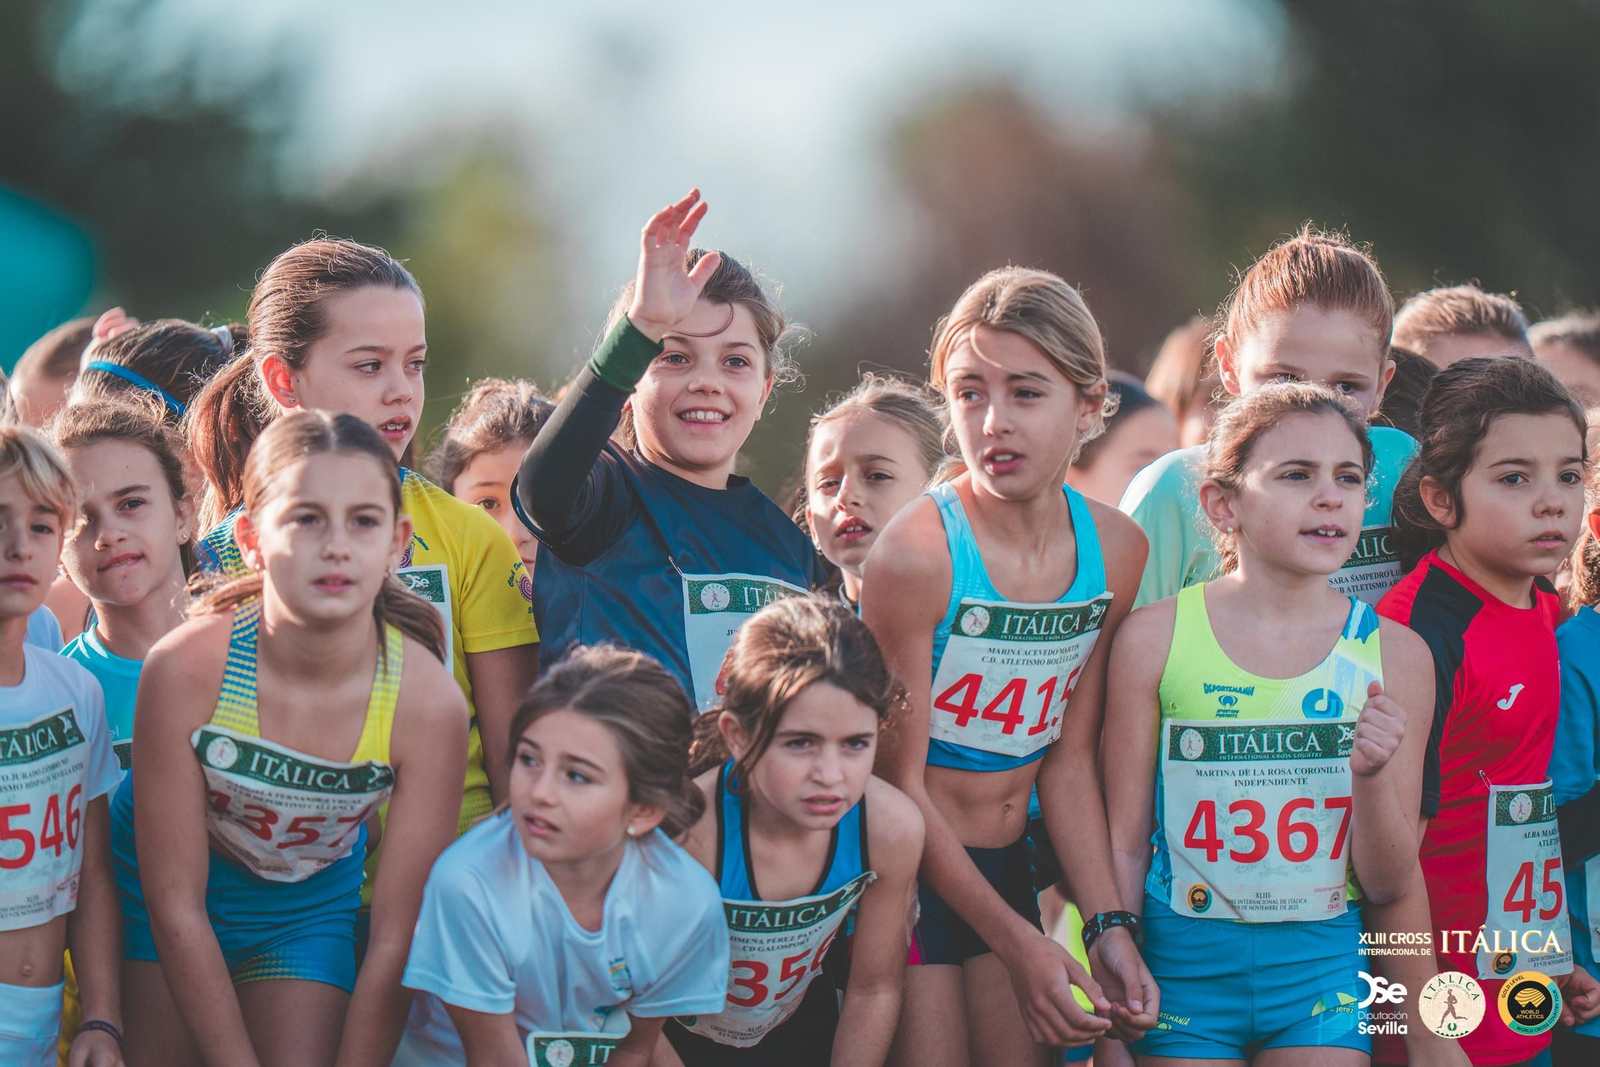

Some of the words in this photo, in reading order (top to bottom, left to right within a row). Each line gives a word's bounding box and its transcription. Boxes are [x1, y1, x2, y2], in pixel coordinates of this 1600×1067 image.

[1328, 575, 1350, 586] SARA
[1350, 569, 1390, 582] SAMPEDRO
[1346, 580, 1388, 594] ATLETISMO
[1001, 611, 1081, 636] ITÁLICA
[987, 646, 1021, 656] MARINA
[1022, 648, 1059, 657] ACEVEDO
[981, 655, 998, 665] C.D.
[999, 657, 1046, 666] ATLETISMO
[1218, 728, 1322, 754] ITÁLICA
[249, 751, 351, 790] ITÁLICA
[1195, 768, 1236, 777] MARTINA
[1238, 768, 1251, 777] DE
[1253, 768, 1265, 776] LA
[1267, 768, 1292, 776] ROSA
[1294, 765, 1346, 776] CORONILLA
[1234, 777, 1308, 787] INDEPENDIENTE
[0, 783, 82, 870] 546
[1183, 795, 1353, 864] 4367
[1522, 830, 1540, 840] ALBA
[730, 904, 827, 928] ITÁLICA
[729, 935, 764, 945] JIMENA
[757, 937, 811, 952] GALOSPORT
